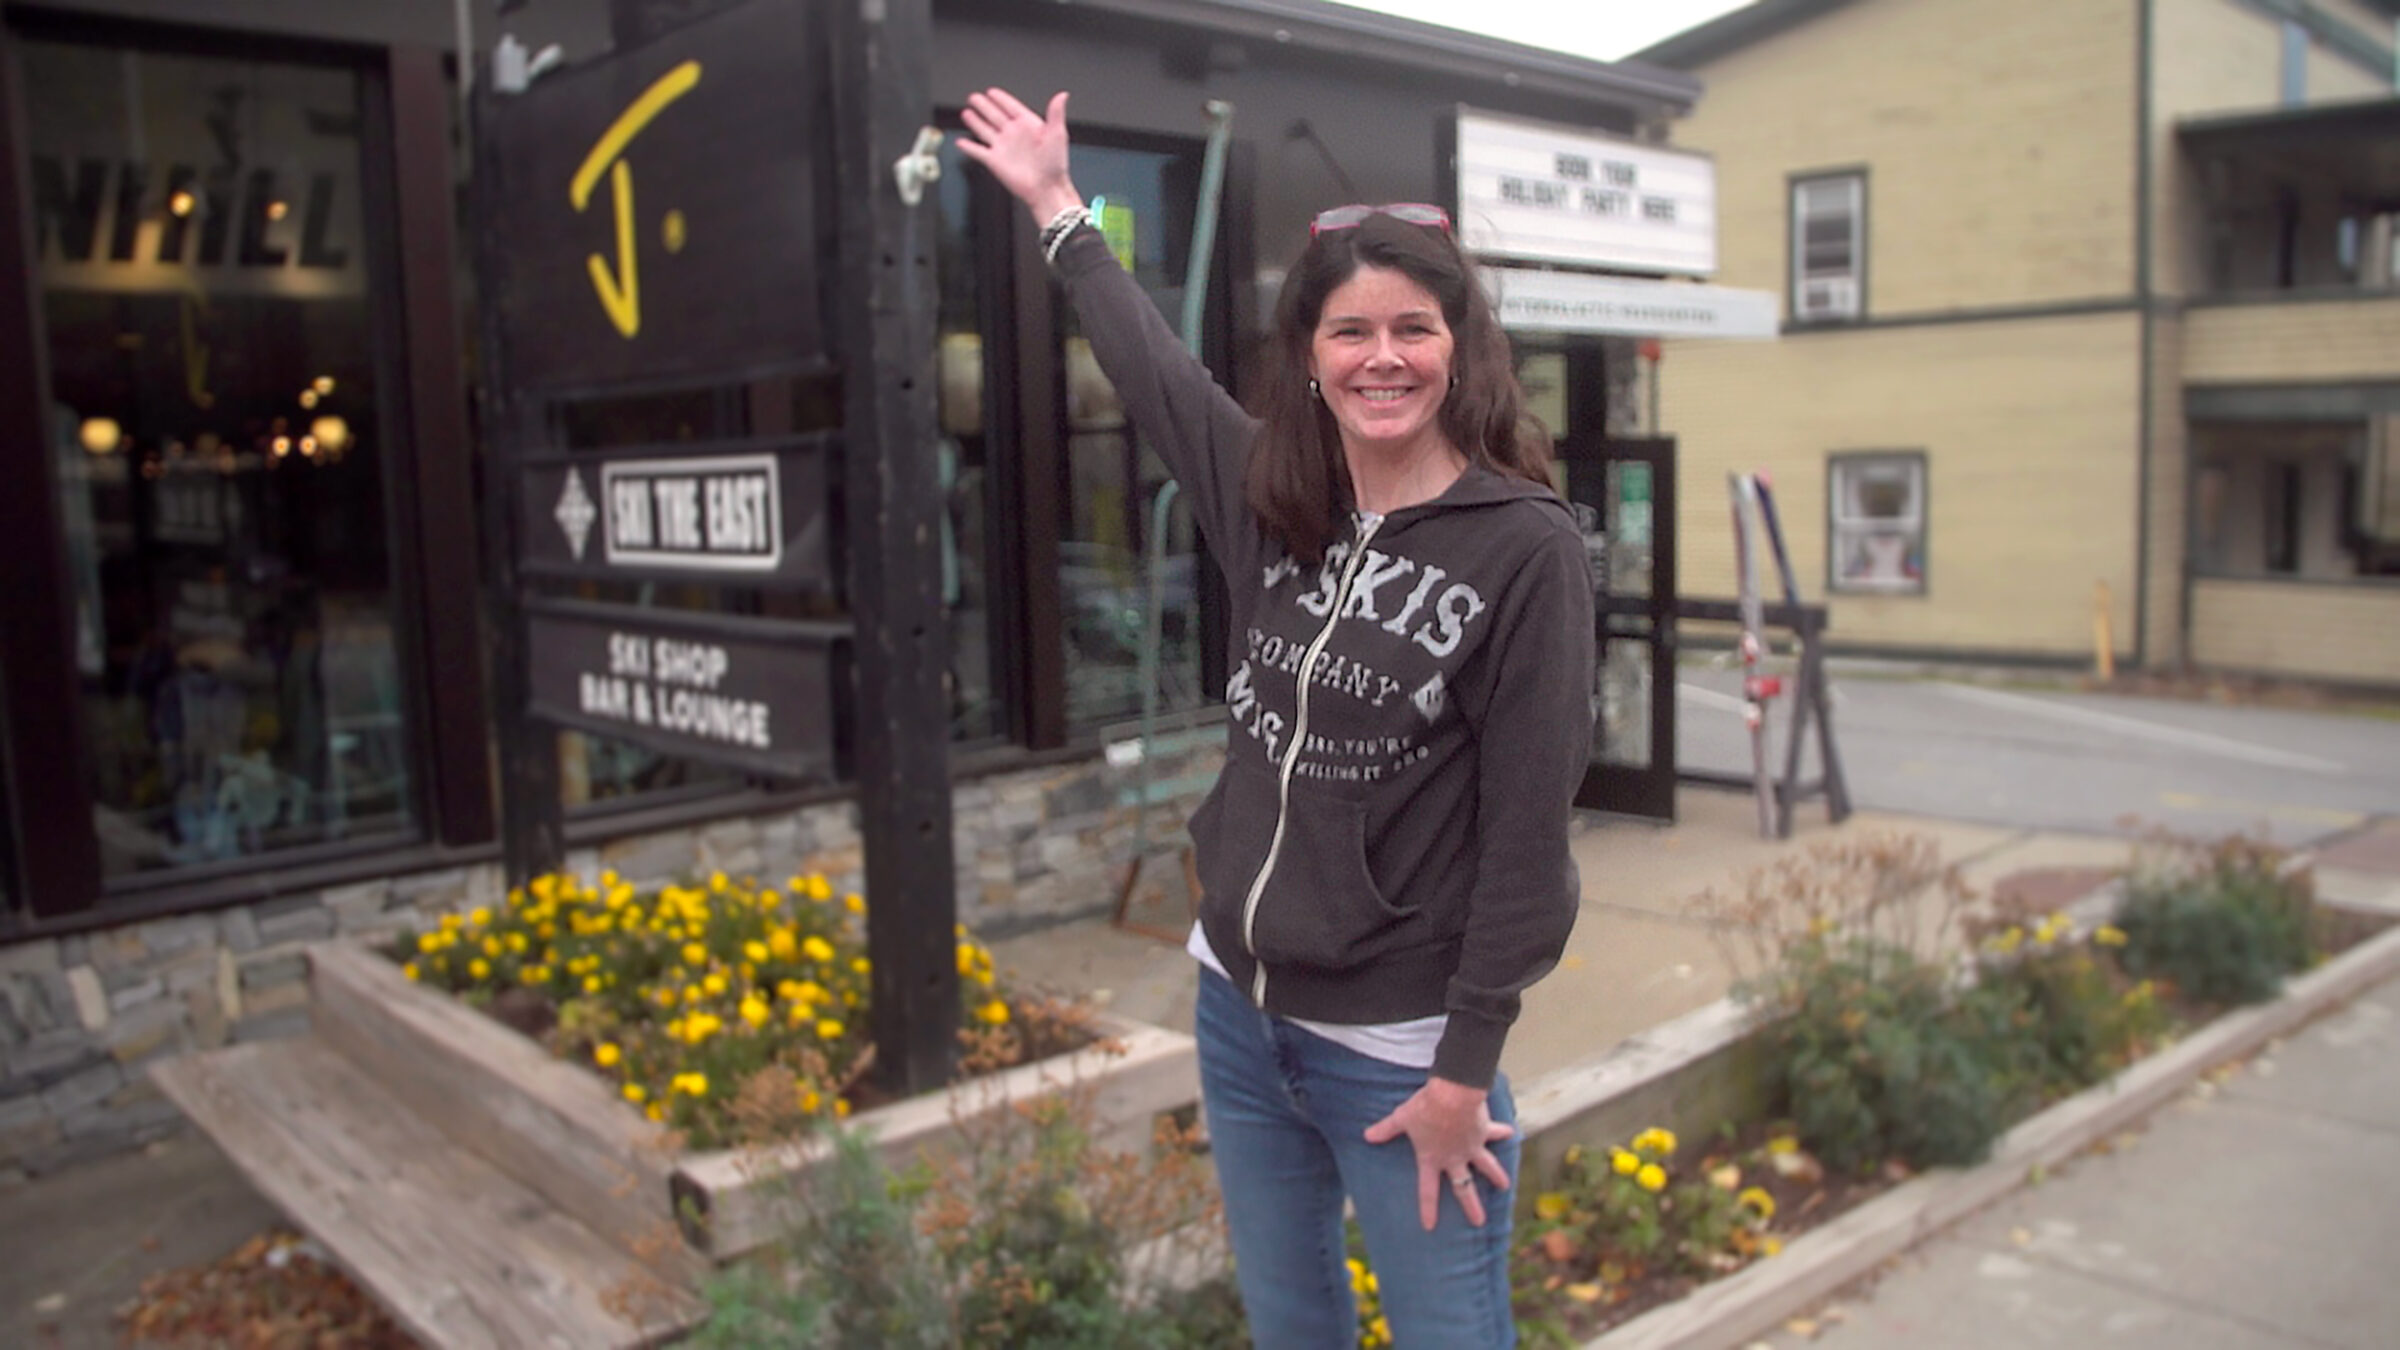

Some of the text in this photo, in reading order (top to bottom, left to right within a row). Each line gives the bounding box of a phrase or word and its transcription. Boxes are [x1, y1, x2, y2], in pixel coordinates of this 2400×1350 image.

[569, 59, 701, 338] J.
[613, 474, 768, 551] SKI THE EAST
[1296, 541, 1486, 658] SKIS
[609, 633, 728, 688] SKI SHOP
[1247, 628, 1400, 707] COMPANY
[579, 672, 771, 748] BAR & LOUNGE
